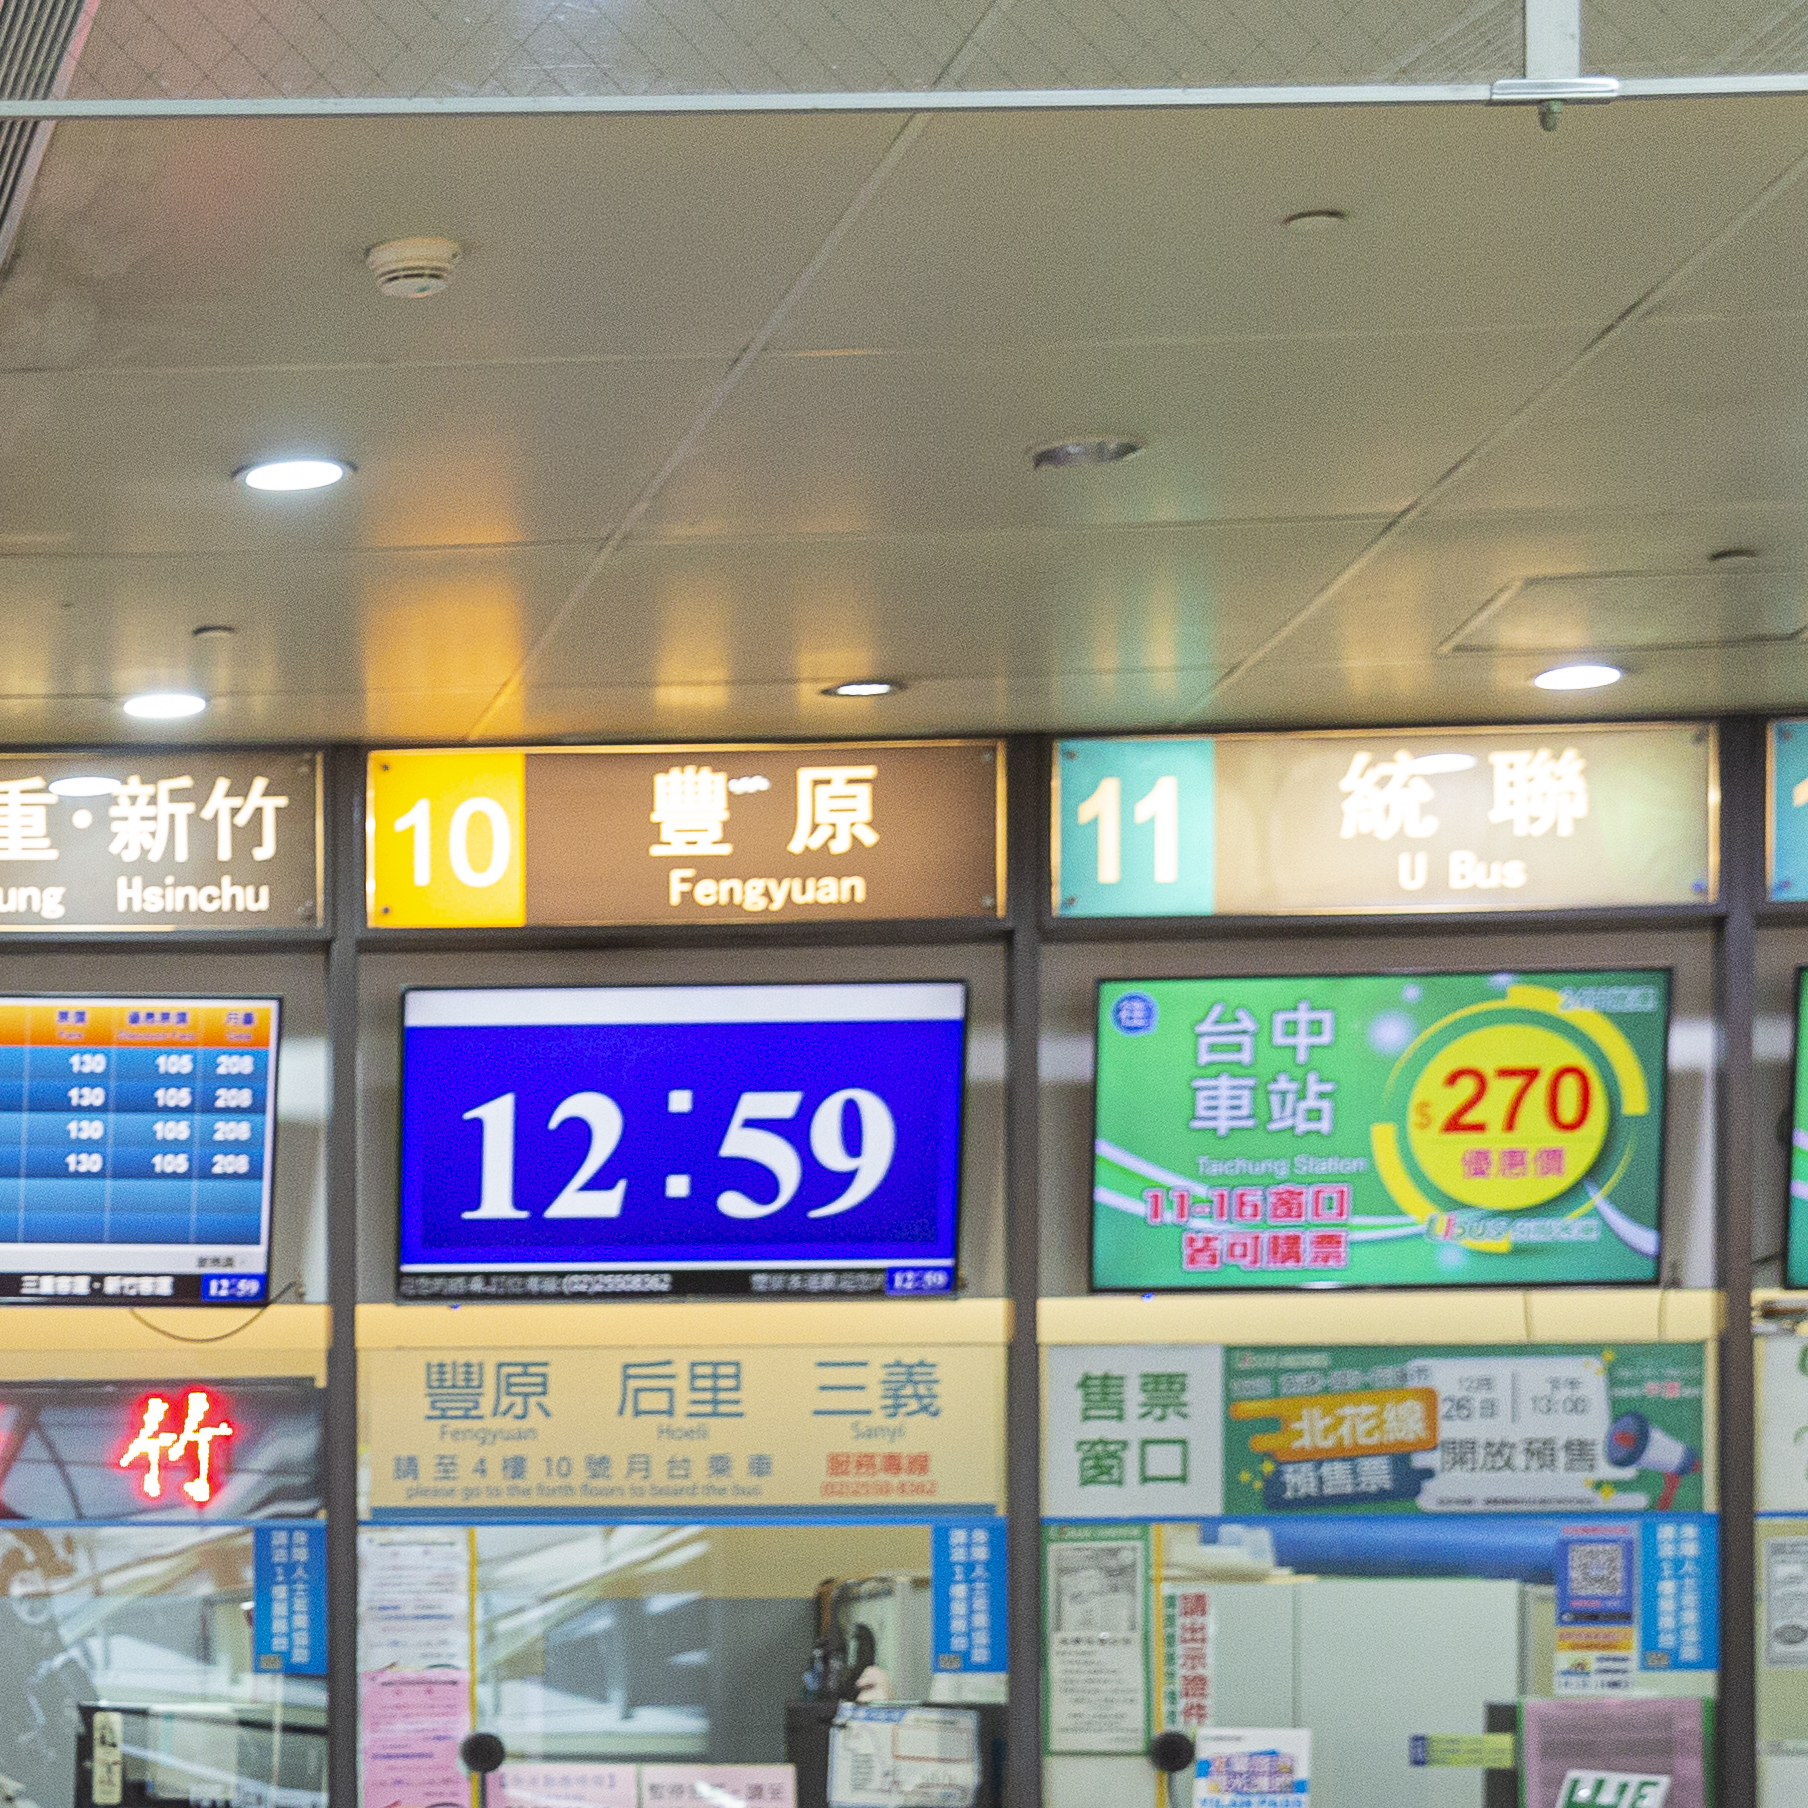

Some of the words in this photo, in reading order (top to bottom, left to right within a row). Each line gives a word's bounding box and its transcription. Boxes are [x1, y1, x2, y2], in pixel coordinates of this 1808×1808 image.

[648, 764, 881, 857] 豐原
[1339, 748, 1587, 840] 統聯
[394, 796, 511, 888] 10
[1077, 777, 1178, 883] 11
[668, 868, 867, 911] Fengyuan
[1398, 853, 1426, 889] U
[1449, 851, 1527, 889] Bus
[116, 875, 270, 913] Hsinchu
[1116, 995, 1153, 1031] 往
[1195, 1001, 1335, 1066] 台中
[69, 1053, 107, 1074] 130
[155, 1054, 194, 1075] 105
[67, 1086, 106, 1107] 130
[154, 1087, 192, 1108] 105
[1191, 1070, 1335, 1137] 車站
[66, 1119, 105, 1140] 130
[152, 1120, 191, 1141] 105
[65, 1152, 103, 1173] 130
[151, 1153, 189, 1173] 105
[461, 1087, 897, 1221] 12:59
[1197, 1155, 1287, 1176] Taichung
[1294, 1154, 1368, 1175] Station
[1462, 1147, 1566, 1179] 優惠價
[1183, 1232, 1349, 1270] 皆可購票
[208, 1277, 261, 1298] 12:59
[423, 1360, 552, 1421] 豐原
[616, 1359, 745, 1420] 后里
[812, 1359, 941, 1419] 三義
[1075, 1371, 1190, 1423] 售票
[439, 1424, 538, 1448] Fengyuan
[851, 1421, 905, 1445] Sanyi
[1291, 1399, 1427, 1451] 北花線
[1075, 1436, 1190, 1489] 窗口
[1441, 1437, 1596, 1472] 開放預售
[1283, 1455, 1393, 1500] 預售票
